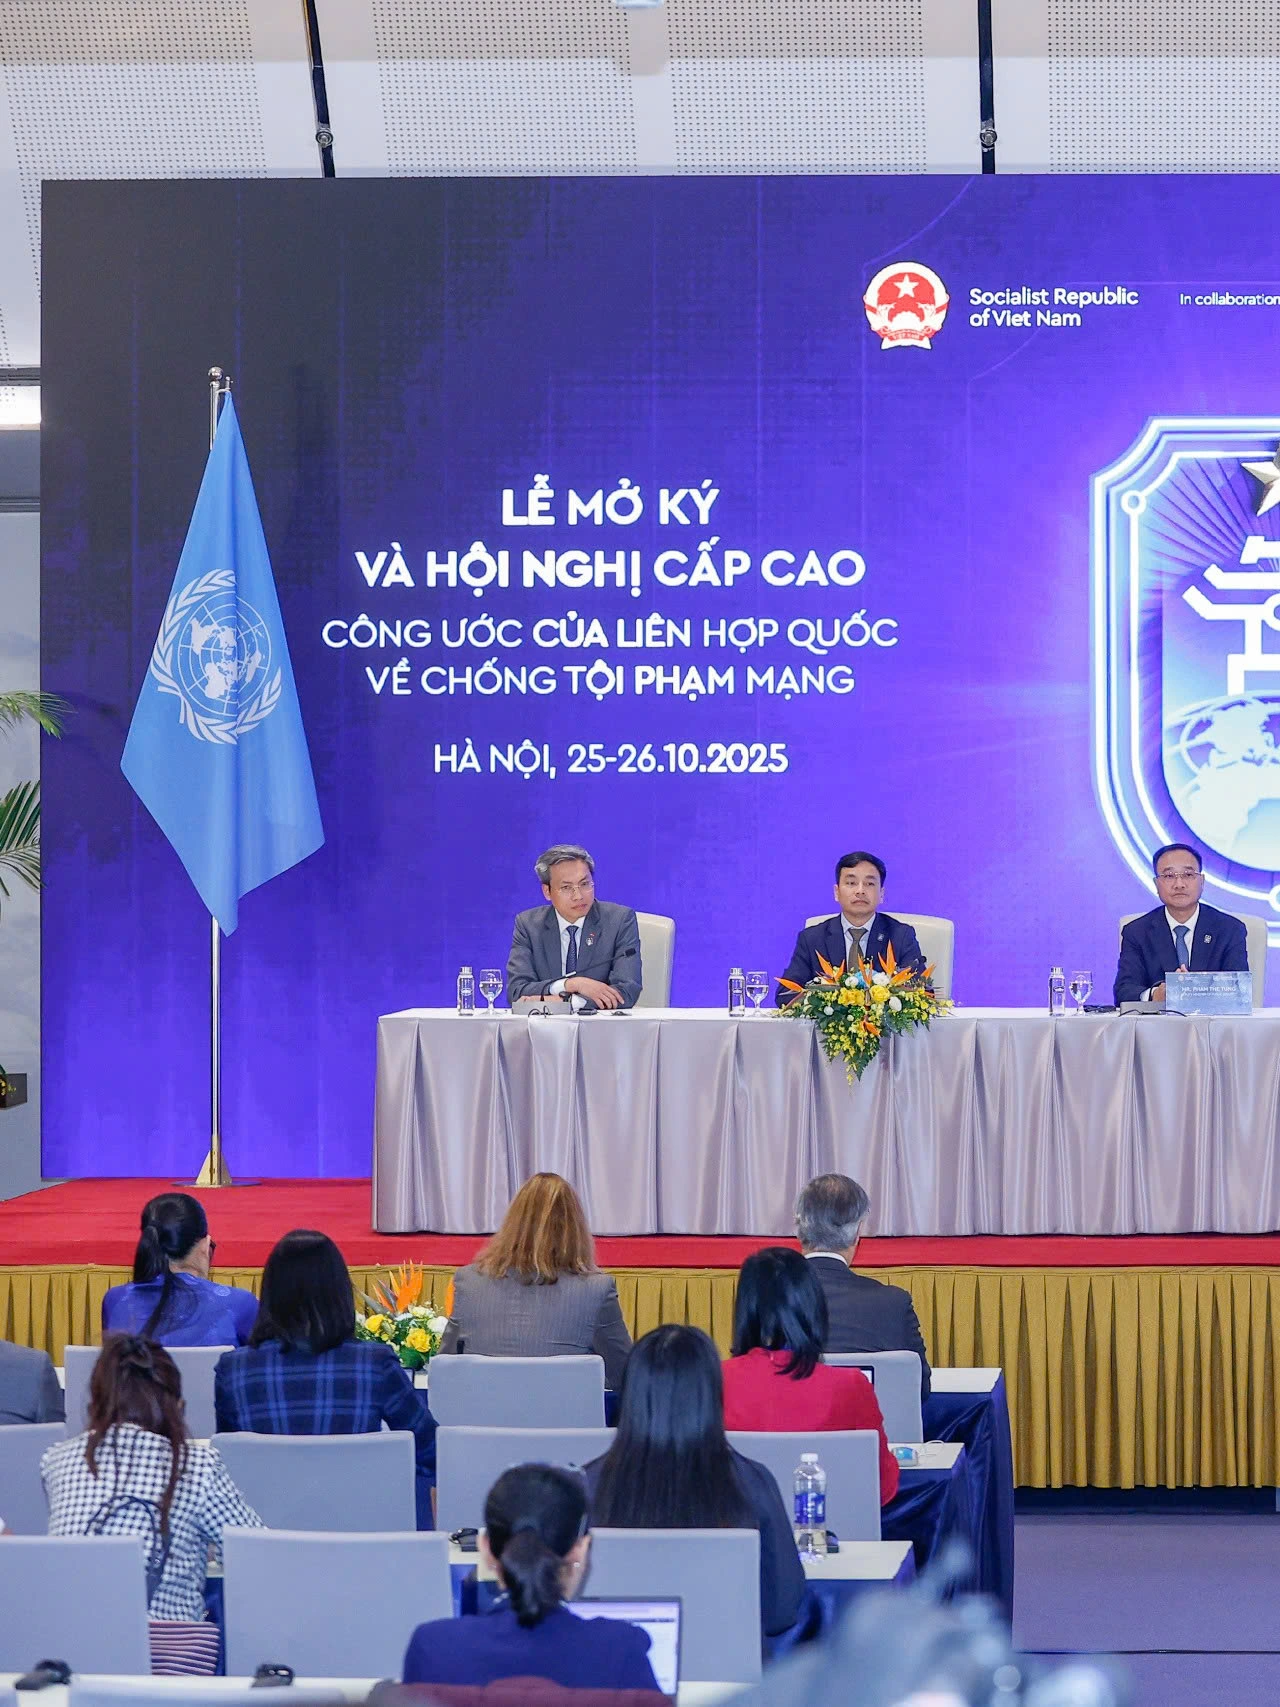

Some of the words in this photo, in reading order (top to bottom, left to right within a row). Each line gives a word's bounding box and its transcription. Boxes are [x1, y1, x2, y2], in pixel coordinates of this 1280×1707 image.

[969, 286, 1050, 305] Socialist
[1053, 286, 1139, 308] Republic
[969, 308, 991, 327] of
[992, 310, 1031, 326] Viet
[1037, 310, 1081, 326] Nam
[1180, 293, 1192, 305] In
[503, 474, 555, 525] LỄ
[568, 478, 643, 525] MỞ
[660, 479, 719, 524] KÝ
[355, 542, 414, 587] VÀ
[427, 541, 509, 597] HỘI
[523, 550, 641, 597] NGHỊ
[654, 537, 750, 586] CẤP
[761, 550, 865, 586] CAO
[322, 614, 431, 647] CÔNG
[442, 613, 522, 647] ƯỚC
[533, 611, 609, 647] CỦA
[617, 613, 690, 647] LIÊN
[704, 617, 778, 653] HỢP
[788, 609, 898, 655] QUỐC
[366, 658, 411, 694] VỀ
[421, 657, 556, 694] CHỐNG
[563, 659, 623, 700] TỘI
[635, 666, 734, 701] PHẠM
[747, 666, 854, 700] MẠNG
[435, 738, 481, 772] HÀ
[490, 739, 556, 779] NỘI,
[568, 743, 788, 772] 25-26.10.2025
